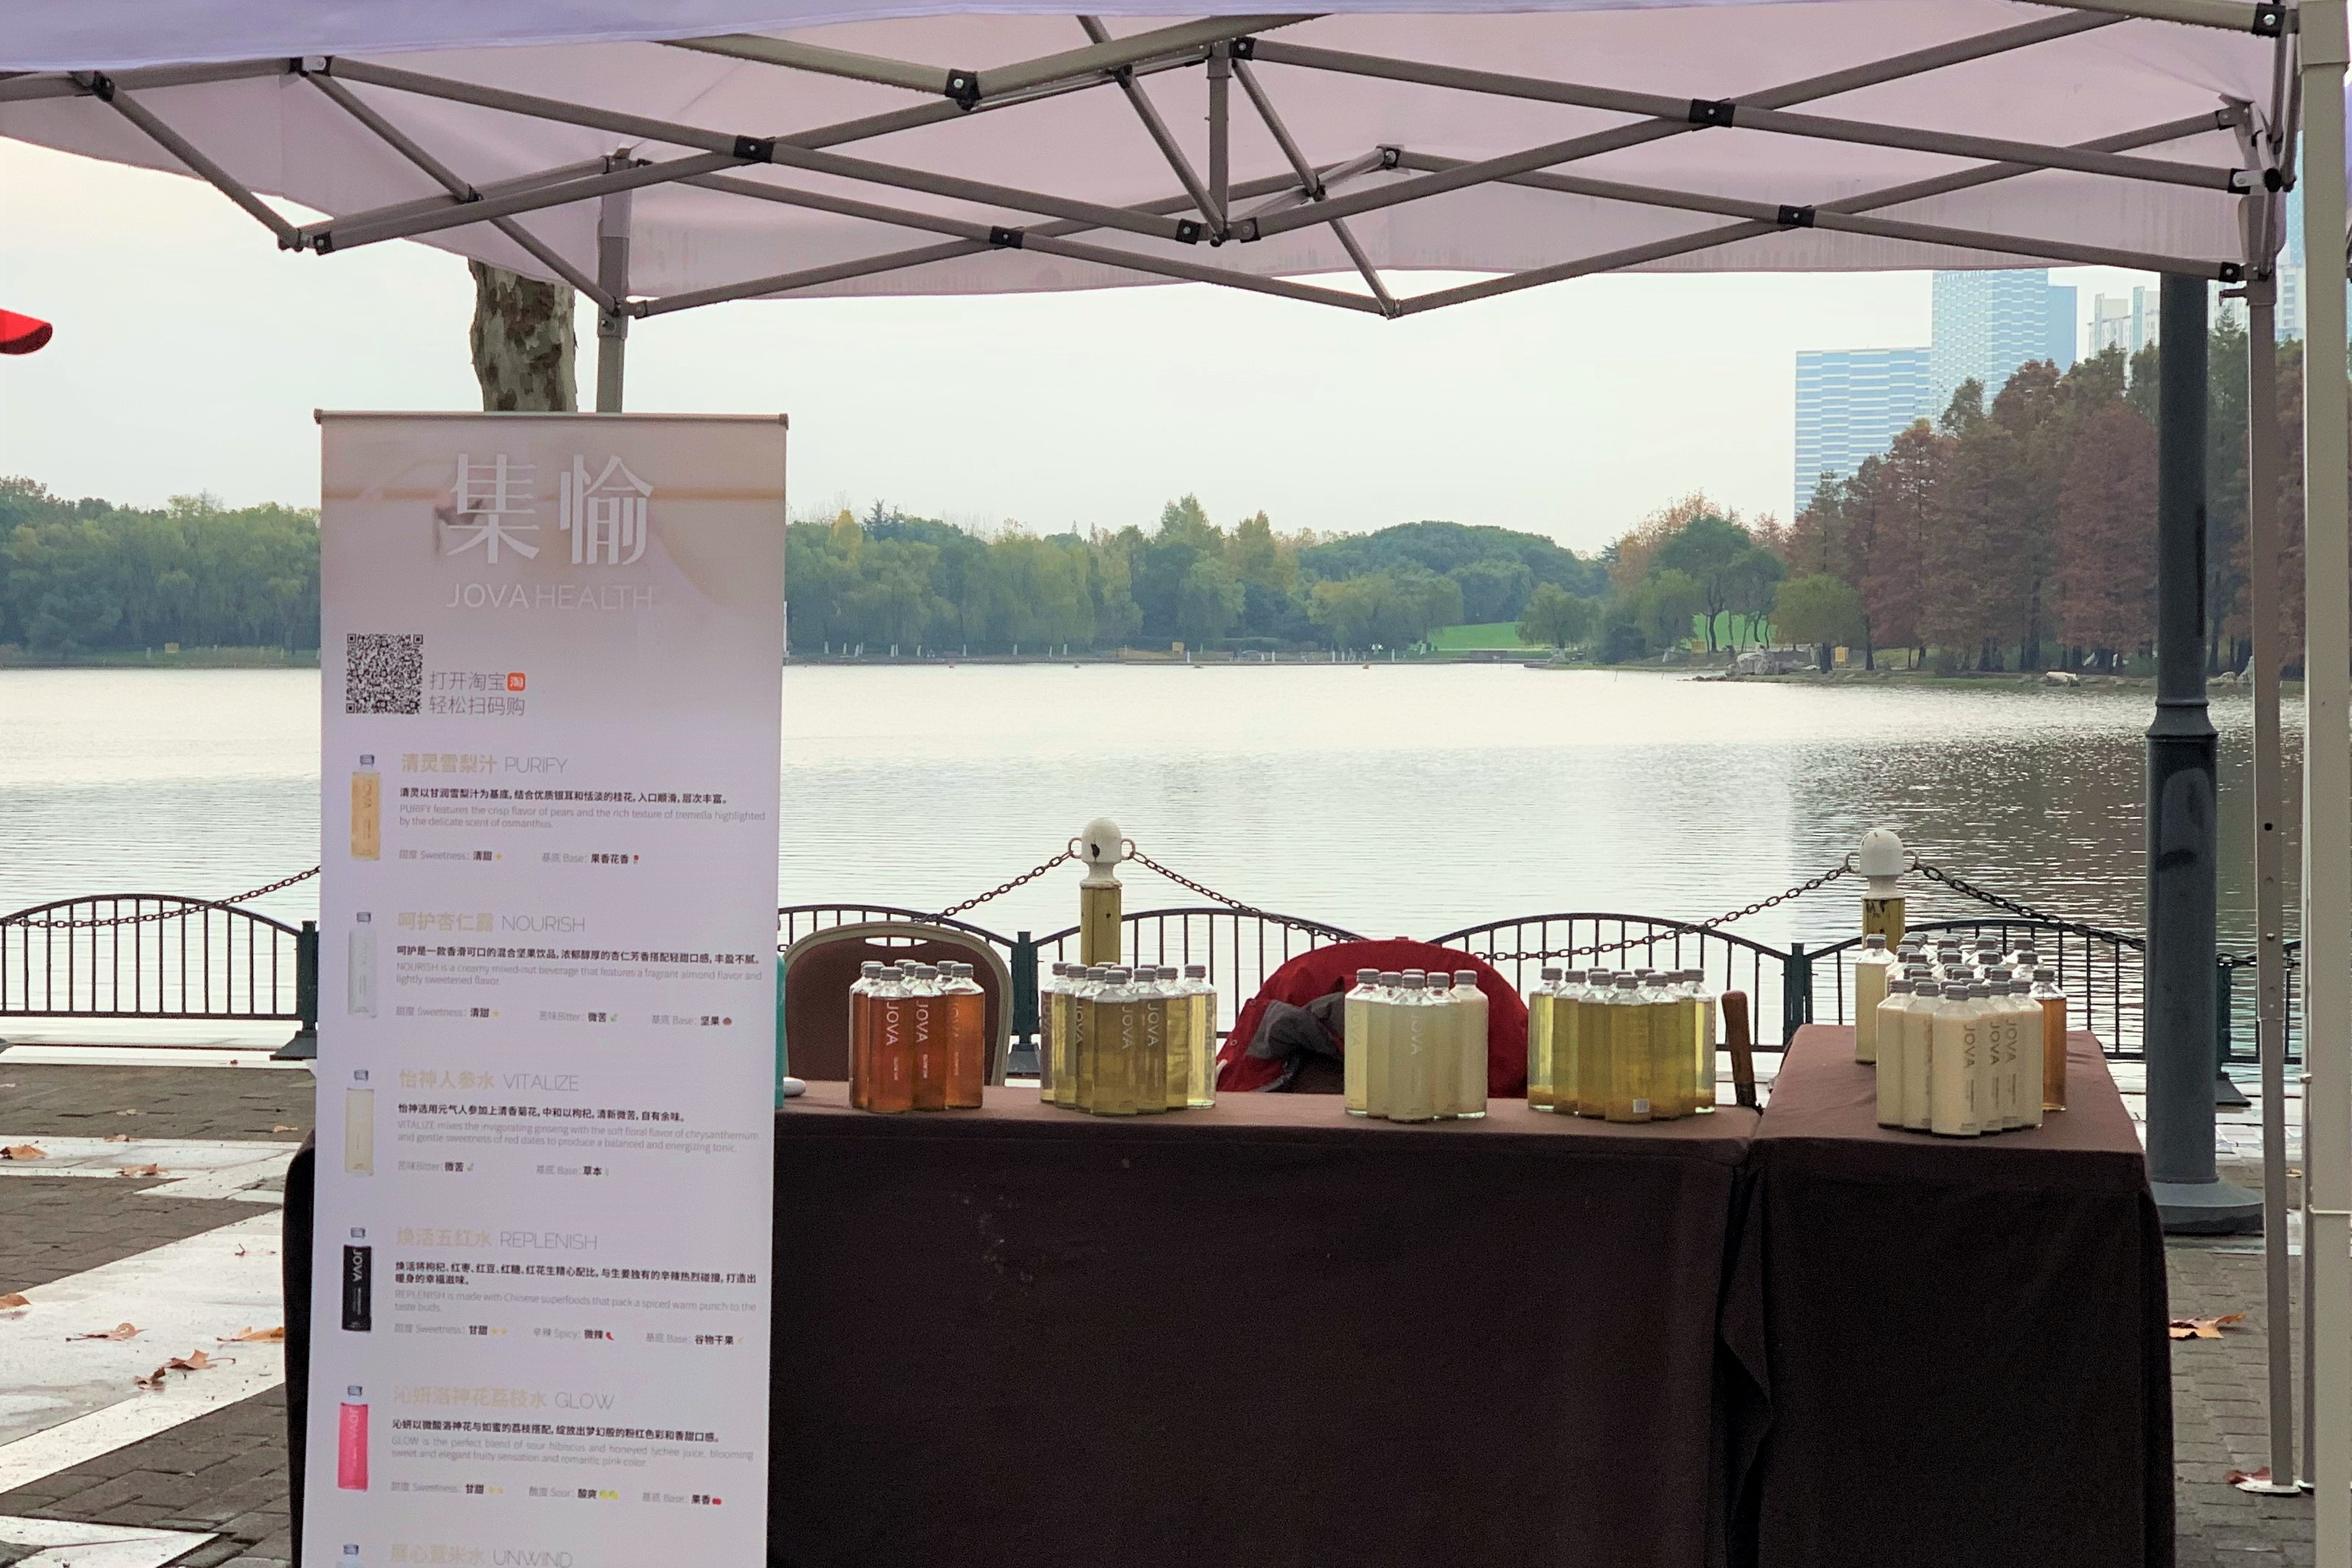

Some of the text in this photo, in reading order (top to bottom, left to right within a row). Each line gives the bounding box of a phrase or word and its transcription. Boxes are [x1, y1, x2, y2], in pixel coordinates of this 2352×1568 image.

[446, 453, 655, 565] 集愉
[446, 583, 652, 610] JOVA HEALTH
[429, 671, 506, 691] 打开淘宝
[429, 695, 526, 716] 轻松扫码购
[505, 756, 567, 774] PURIFY
[399, 804, 765, 824] PURIFY features the crisp flavor of pears and the rich texture of tremella highlighted
[399, 816, 409, 829] by
[412, 816, 427, 826] the
[428, 817, 463, 827] delicate
[465, 818, 488, 827] scent
[490, 818, 500, 828] of
[502, 915, 585, 933] NOURISH
[396, 961, 438, 972] NOURISH
[457, 965, 490, 975] creamy
[539, 965, 579, 978] beverage
[580, 966, 598, 976] that
[600, 966, 636, 977] features
[645, 968, 679, 981] fragrant
[682, 969, 715, 979] almond
[718, 970, 742, 980] flavor
[745, 971, 762, 980] and
[396, 972, 422, 985] lightly
[424, 974, 472, 984] sweetened
[885, 1002, 899, 1046] JOVA
[916, 1000, 929, 1043] JOVA
[1122, 1006, 1134, 1049] JOVA
[1147, 1003, 1160, 1046] JOVA
[1964, 1024, 1975, 1068] JOVA
[1990, 1021, 2000, 1065] JOVA
[2006, 1019, 2018, 1062] JOVA
[504, 1073, 579, 1091] VITALIZE
[397, 1119, 435, 1130] VITALIZE
[437, 1120, 463, 1131] mixes
[465, 1121, 479, 1131] the
[481, 1122, 532, 1136] invigorating
[534, 1123, 569, 1136] ginseng
[570, 1125, 589, 1135] with
[591, 1125, 605, 1135] the
[607, 1125, 623, 1136] soft
[624, 1126, 646, 1136] floral
[649, 1127, 673, 1137] flavor
[685, 1128, 758, 1143] chrysanthemum
[397, 1131, 415, 1141] and
[416, 1132, 444, 1144] gentle
[446, 1133, 492, 1144] sweetness
[504, 1135, 519, 1144] red
[522, 1135, 545, 1145] dates
[558, 1136, 595, 1150] produce
[604, 1138, 645, 1149] balanced
[646, 1139, 663, 1150] and
[666, 1140, 711, 1154] energizing
[501, 1231, 597, 1249] REPLENISH
[352, 1249, 363, 1282] JOVA
[555, 1392, 615, 1410] GLOW
[493, 1549, 573, 1568] UNWIND
